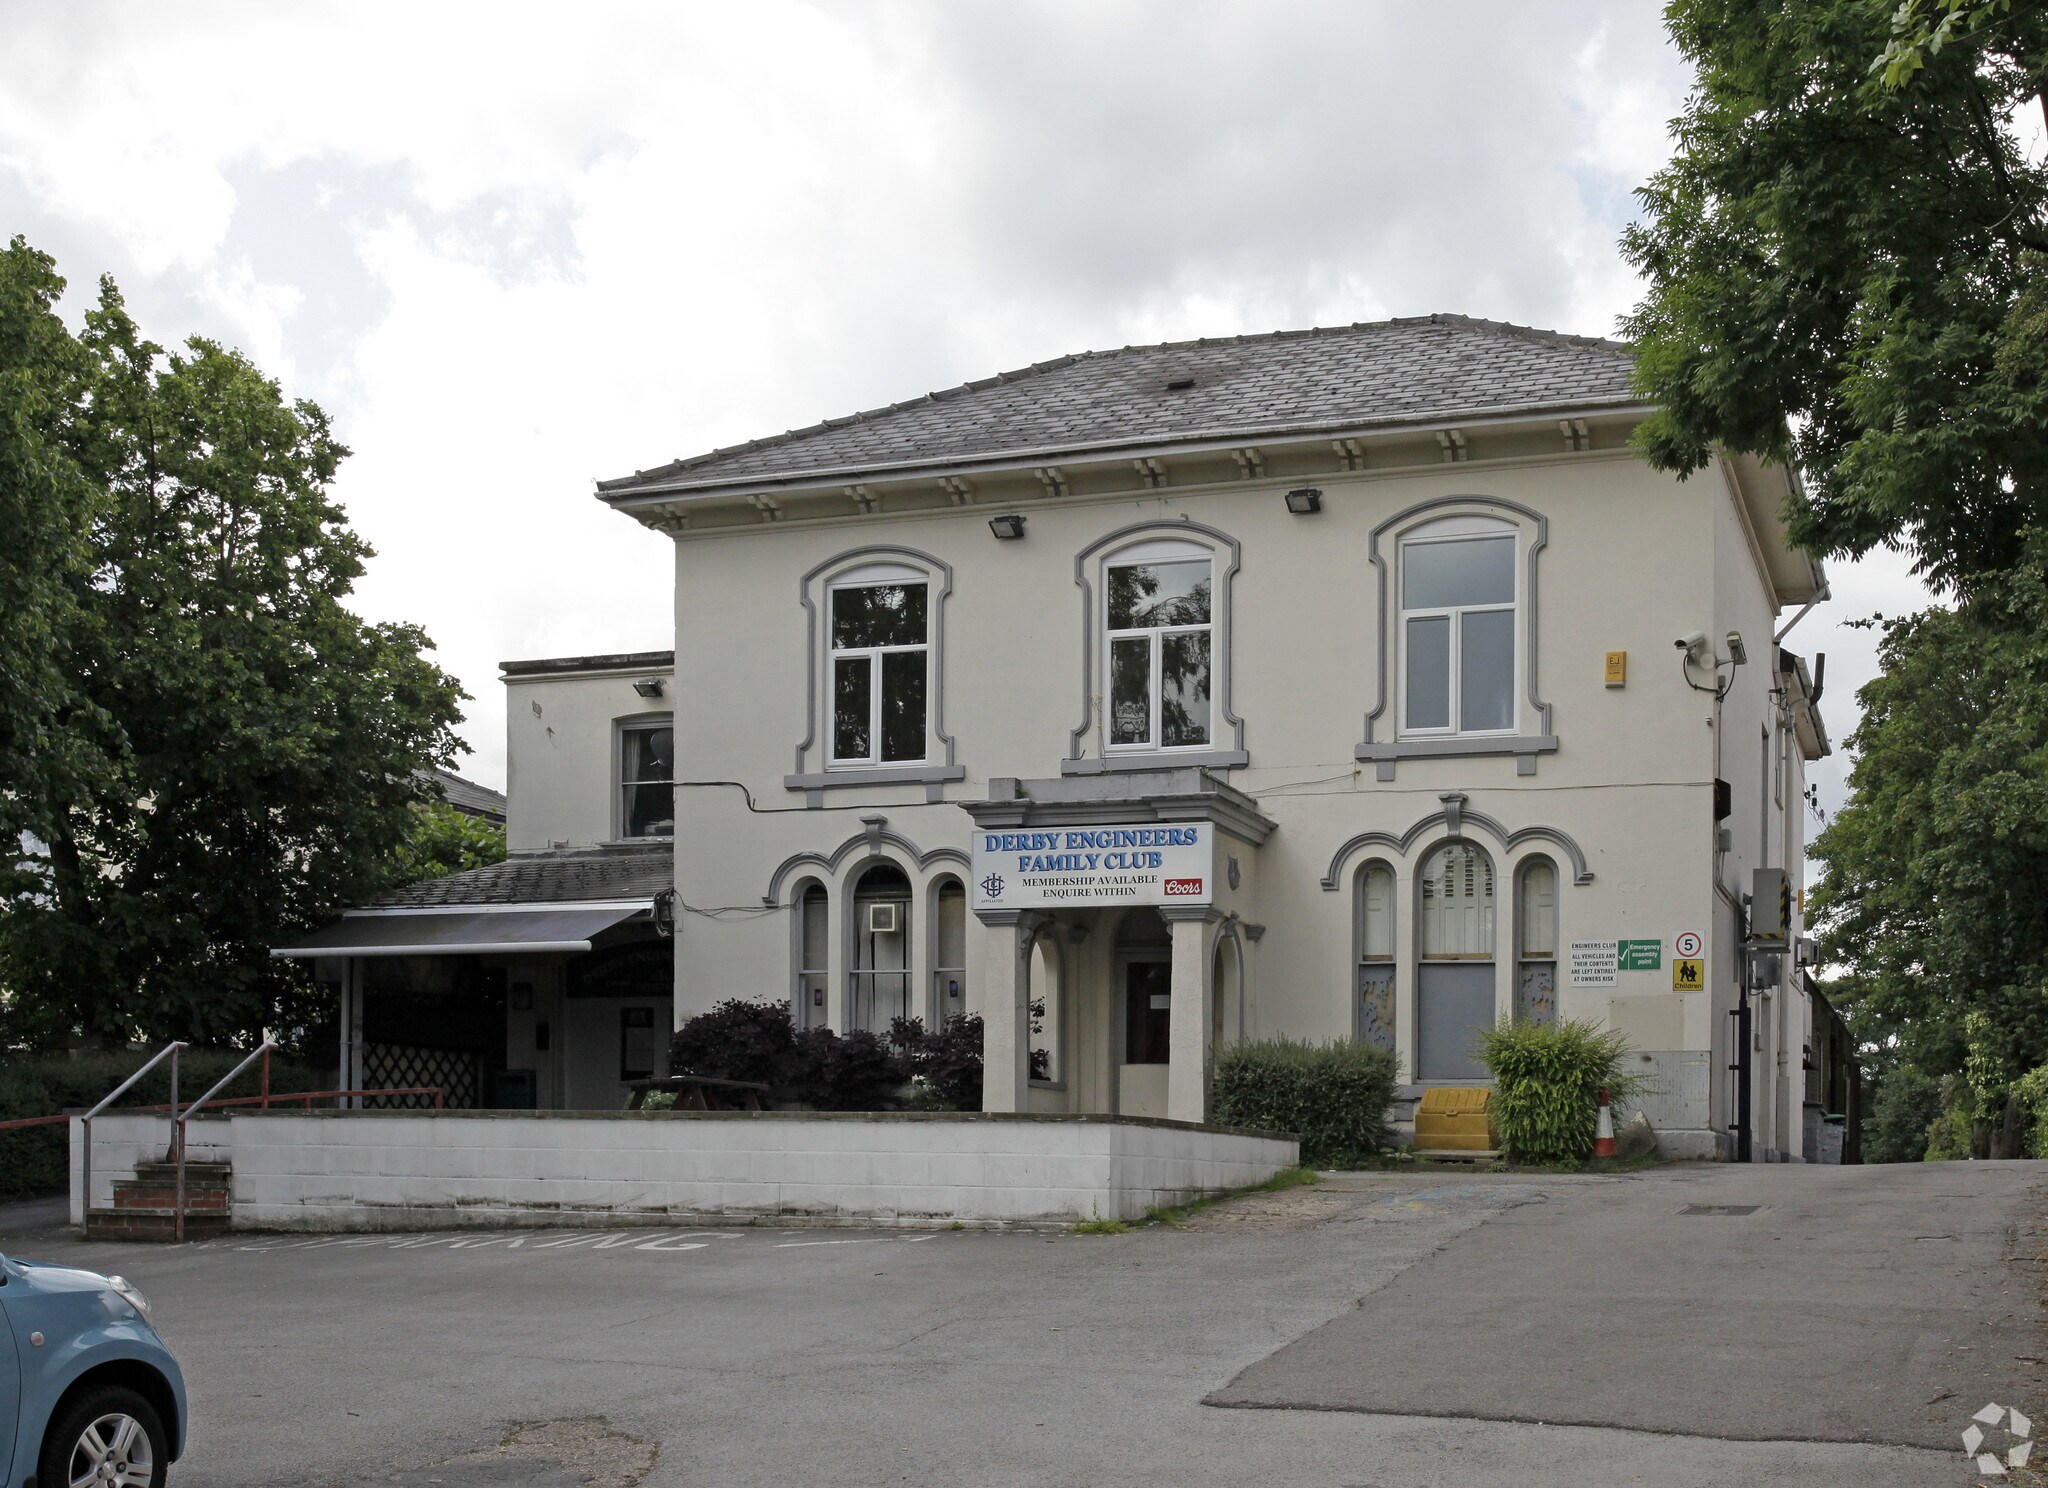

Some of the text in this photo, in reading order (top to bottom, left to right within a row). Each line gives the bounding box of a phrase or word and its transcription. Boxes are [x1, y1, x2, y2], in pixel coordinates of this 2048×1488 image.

[985, 827, 1198, 852] DERBY ENGINEERS
[1018, 851, 1163, 872] FAMILY CLUB
[1022, 875, 1158, 887] MEMBERSHIP AVAILABLE
[1165, 880, 1201, 894] Coors
[1043, 887, 1136, 899] ENQUIRE WITHIN
[1684, 938, 1693, 951] 5
[1637, 958, 1652, 966] point
[303, 1232, 745, 1251] PARKING
